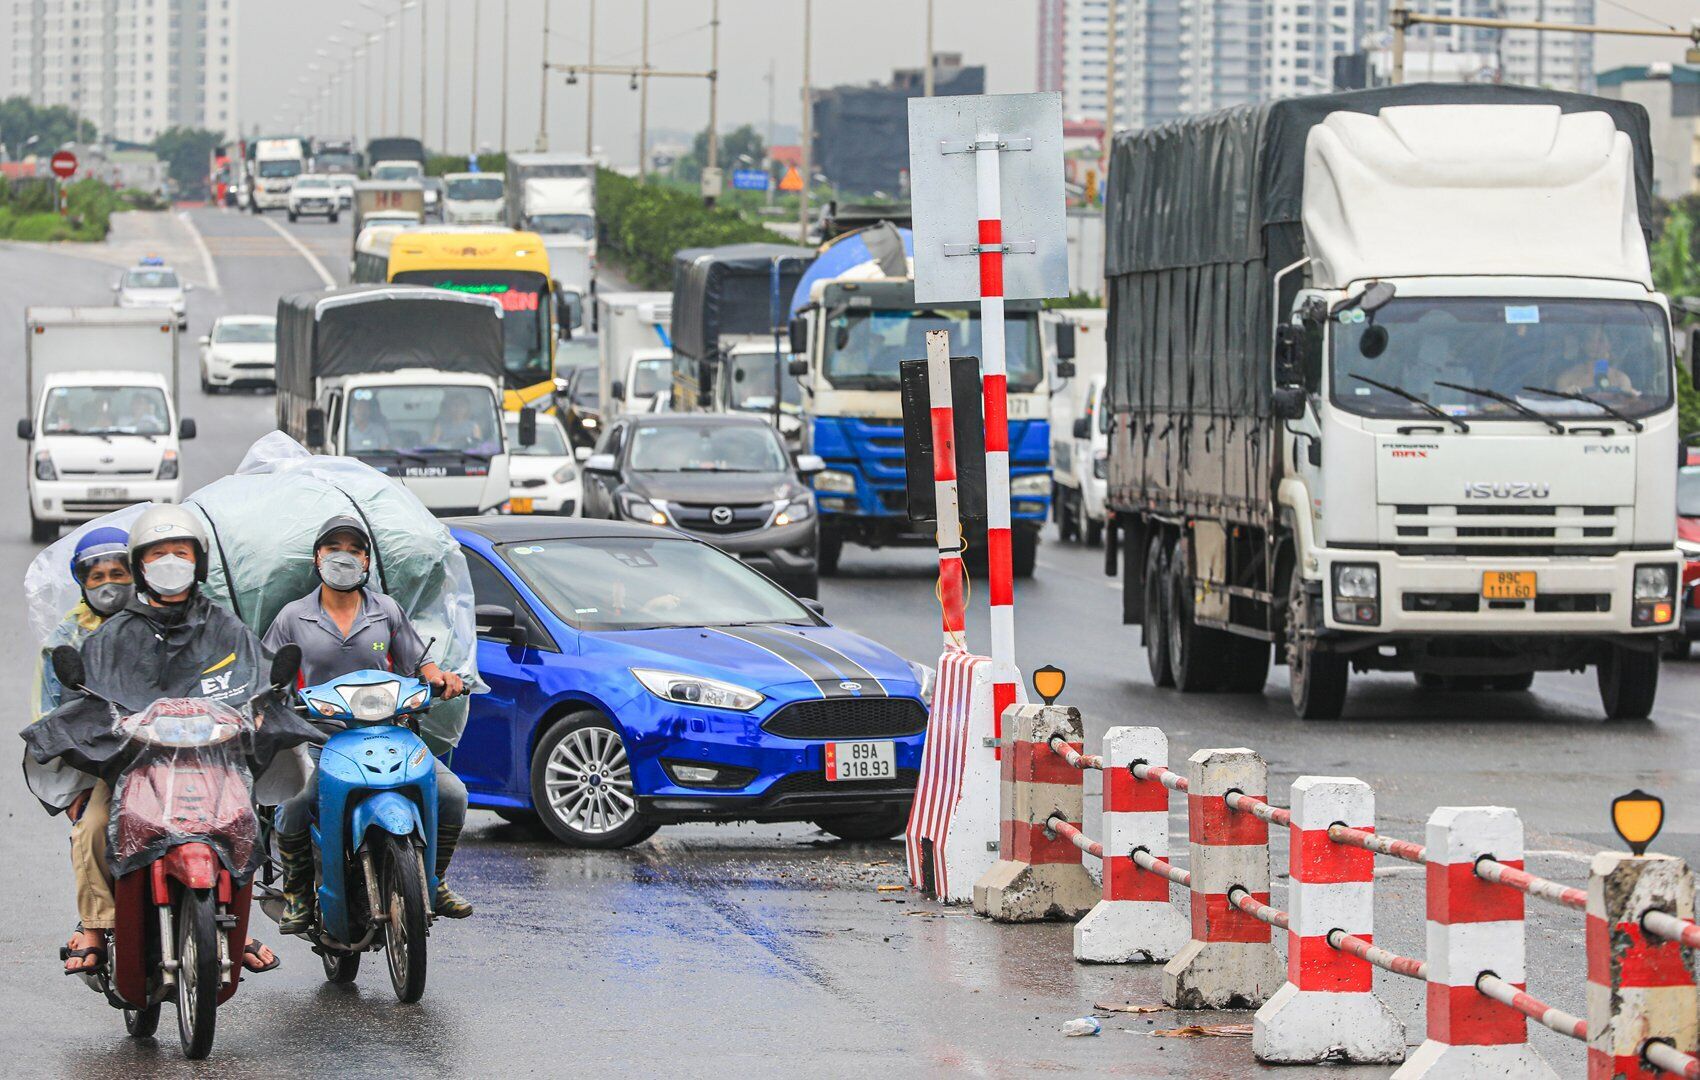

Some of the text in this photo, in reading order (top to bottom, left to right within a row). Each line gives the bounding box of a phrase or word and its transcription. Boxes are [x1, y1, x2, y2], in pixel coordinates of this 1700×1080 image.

[1584, 445, 1630, 454] FVM
[1465, 481, 1550, 499] ISUZU
[1498, 571, 1521, 584] 89C
[1490, 585, 1530, 598] 111.60
[200, 671, 233, 694] EY
[852, 743, 878, 759] 89A
[842, 761, 889, 777] 318.93
